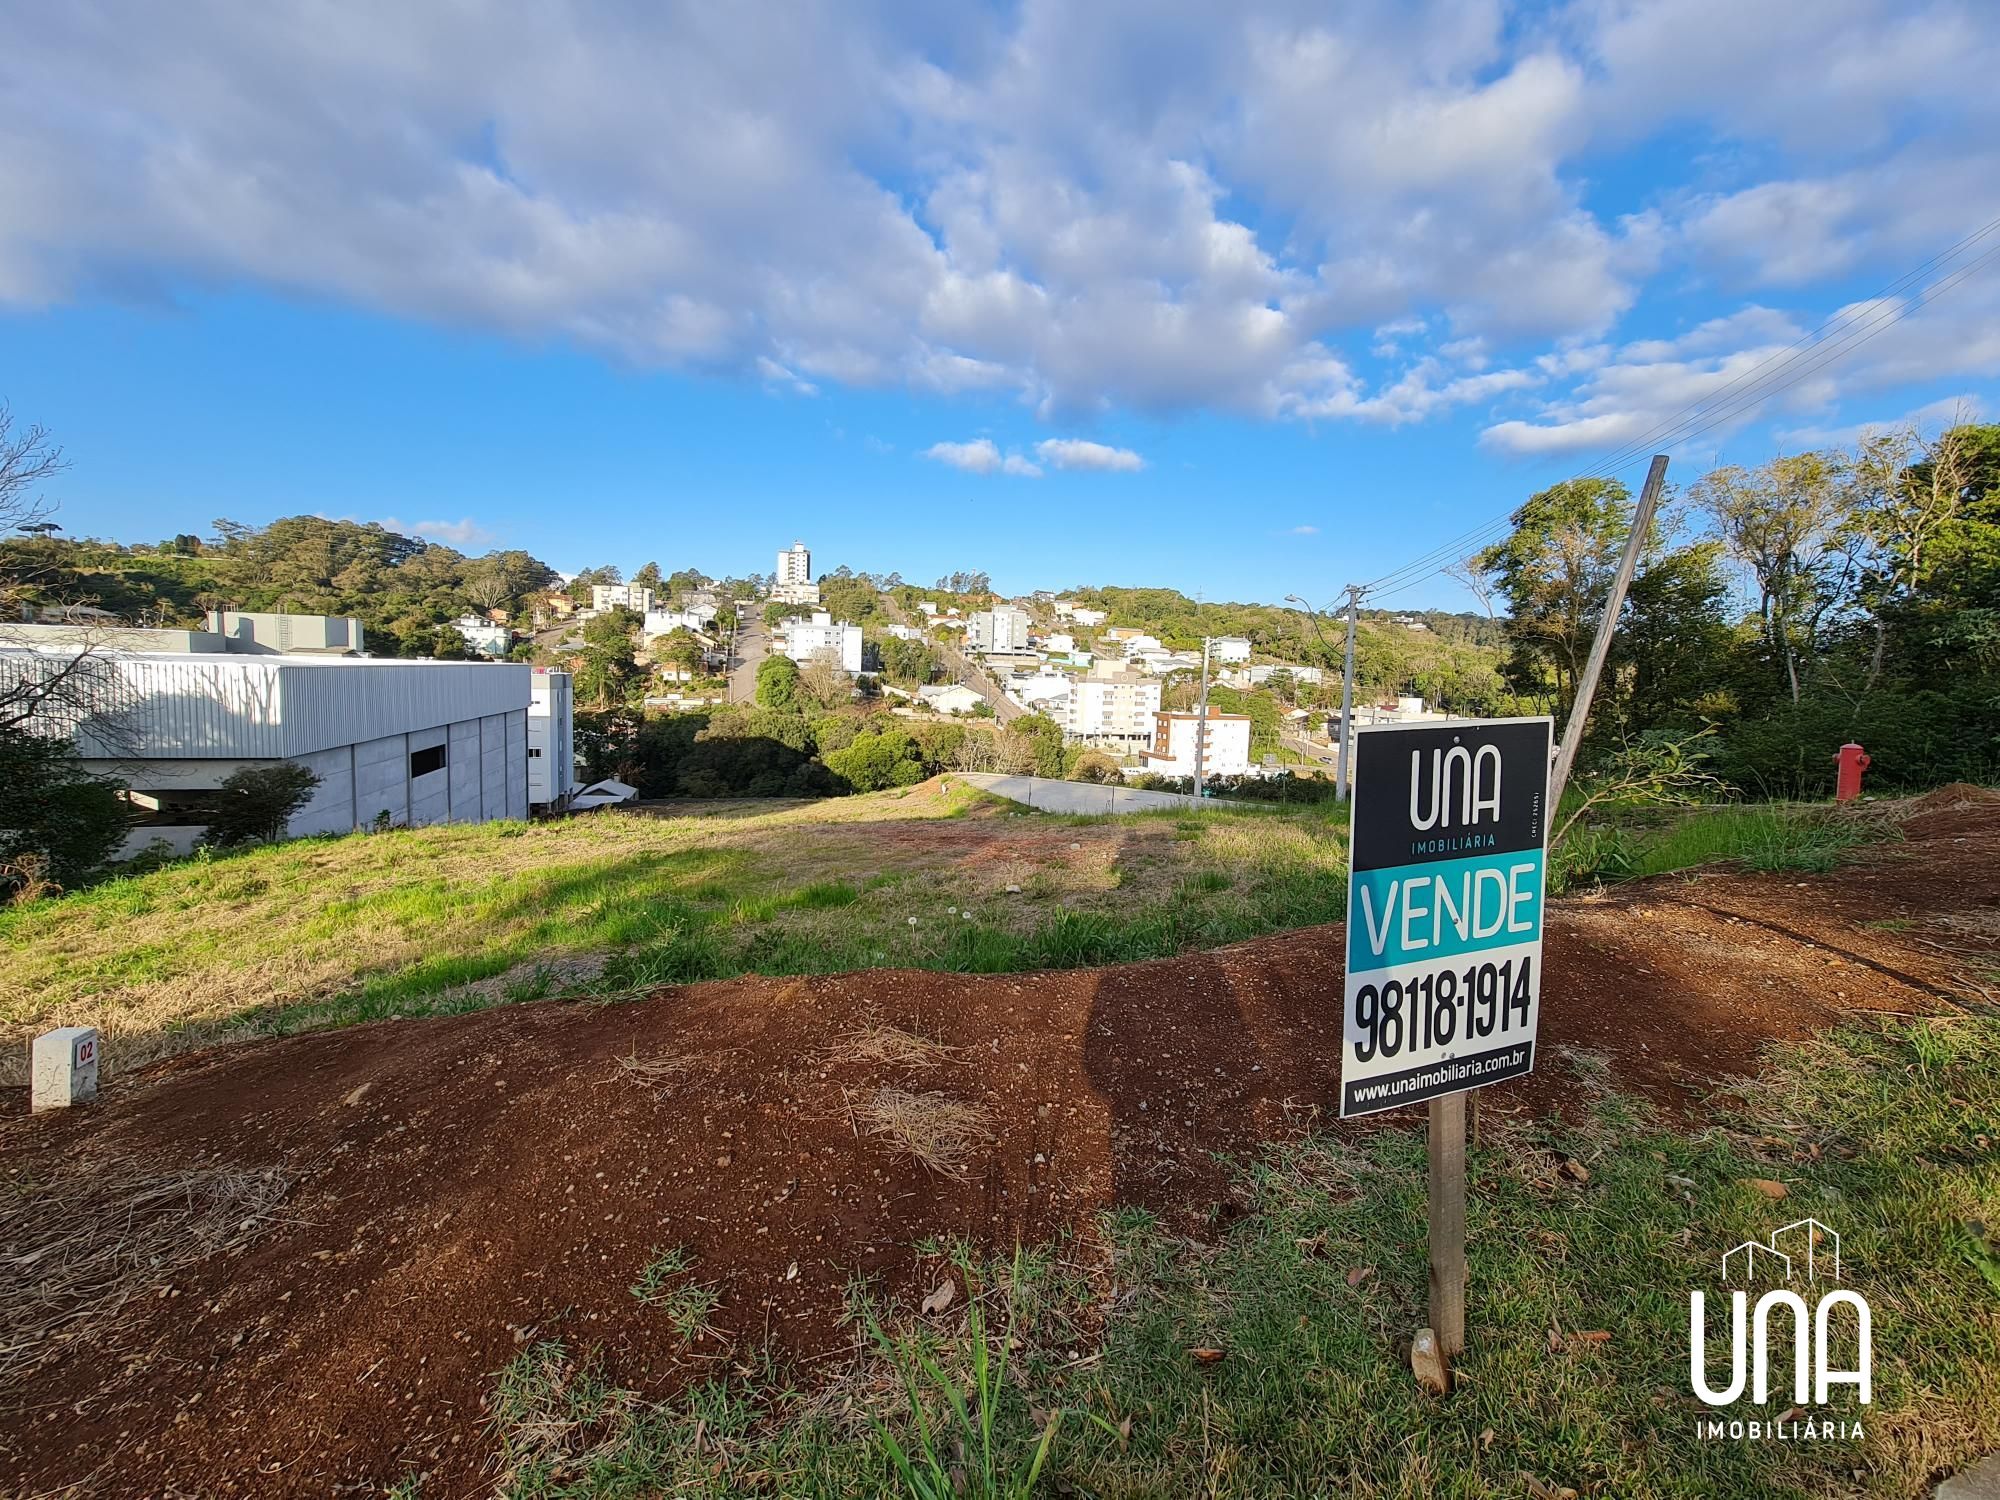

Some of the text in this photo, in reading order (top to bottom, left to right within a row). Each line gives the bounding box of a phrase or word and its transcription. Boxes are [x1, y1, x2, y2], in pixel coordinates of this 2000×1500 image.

[1410, 744, 1502, 831] UNA
[1411, 832, 1496, 855] IMOBILIÁRIA
[1360, 863, 1536, 956] VENDE
[1354, 956, 1531, 1063] 98118-1914
[81, 1041, 93, 1061] 02
[1354, 1050, 1526, 1103] www.unaimobiliaria.com.br
